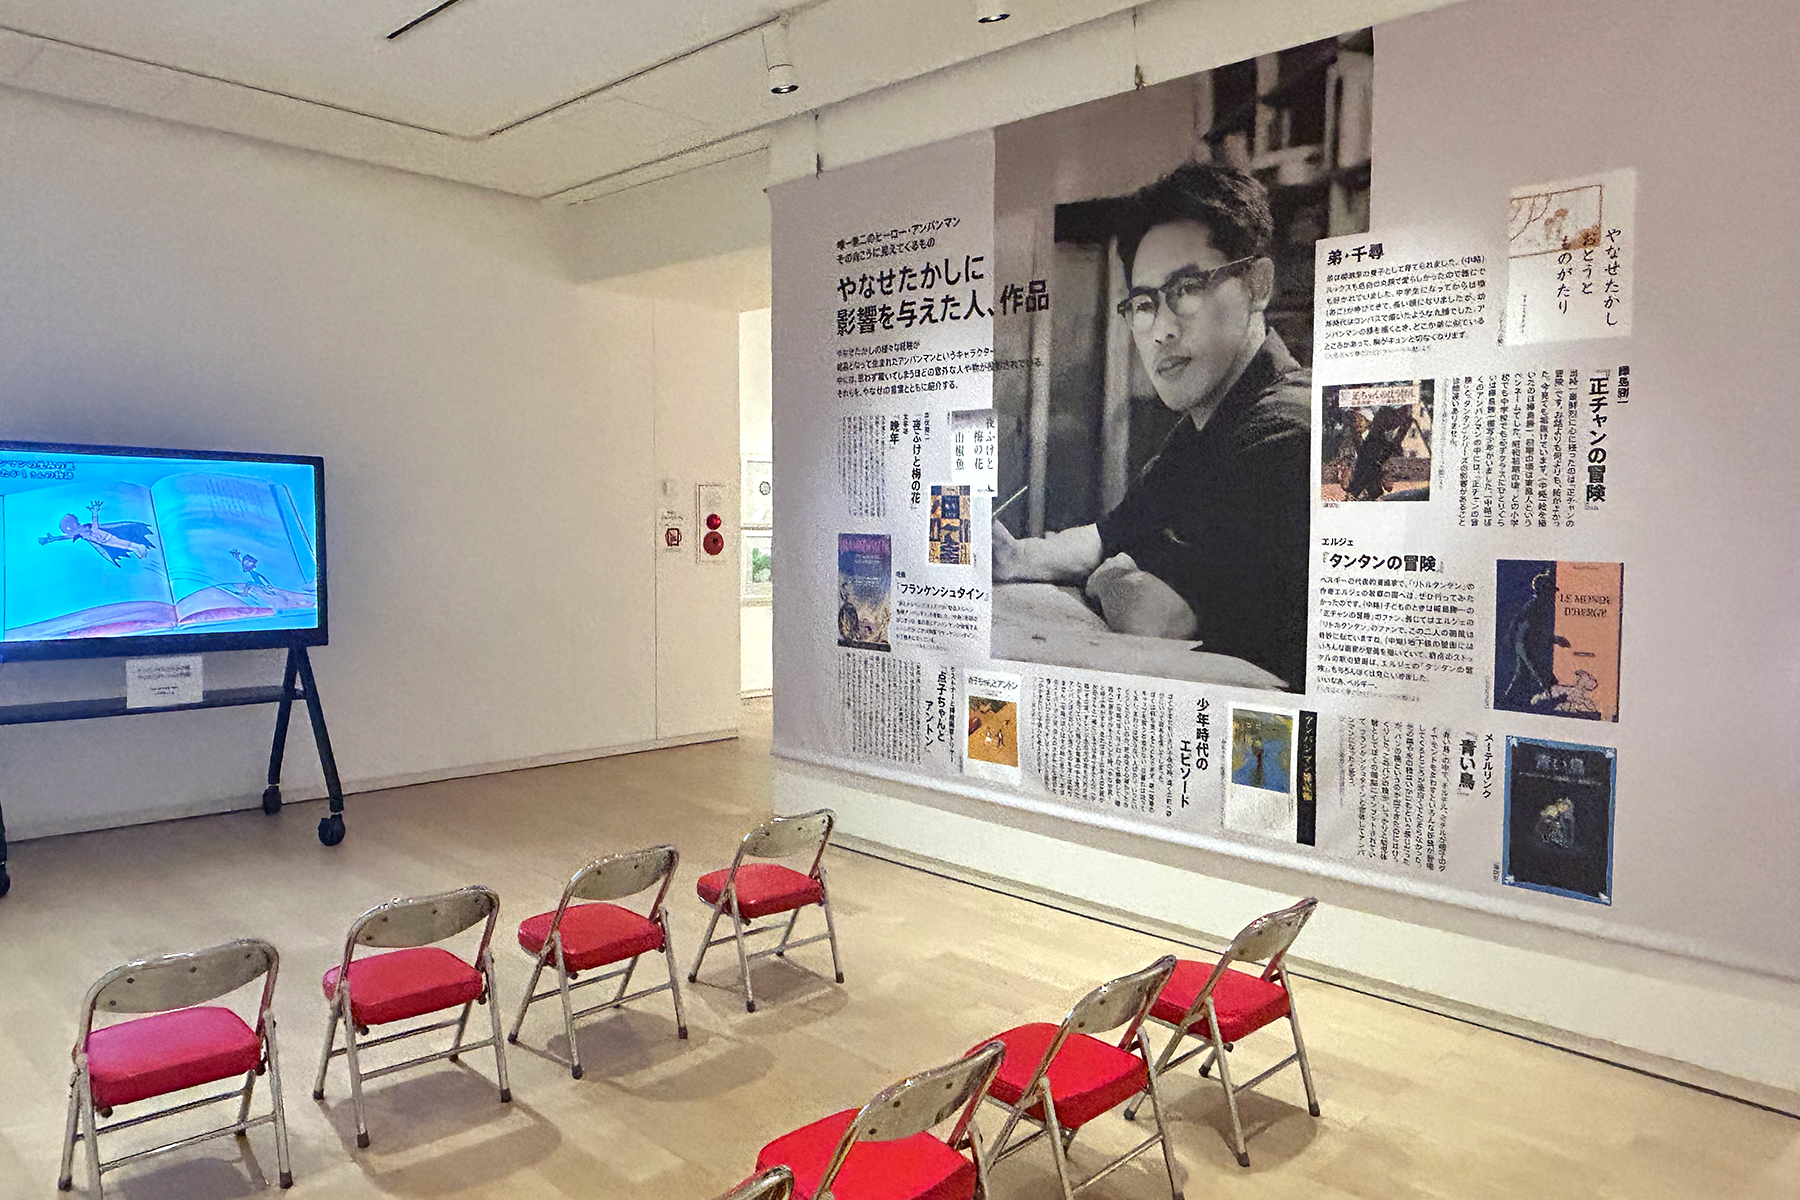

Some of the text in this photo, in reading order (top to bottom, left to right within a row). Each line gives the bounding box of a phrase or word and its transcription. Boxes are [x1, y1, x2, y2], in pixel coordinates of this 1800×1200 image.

[836, 255, 984, 302] やなせたかしに
[1326, 243, 1384, 266] 弟・千尋
[1557, 235, 1573, 314] ものがたり
[1604, 228, 1621, 326] やなせたかし
[836, 280, 1050, 336] 影響を与えた人、作品
[1321, 537, 1354, 547] エルジェ
[1322, 551, 1444, 574] 『タンタンの冒険』
[1196, 698, 1210, 771] 少年時代の
[1181, 739, 1192, 808] エピソード
[1483, 733, 1493, 799] メーテルリンク
